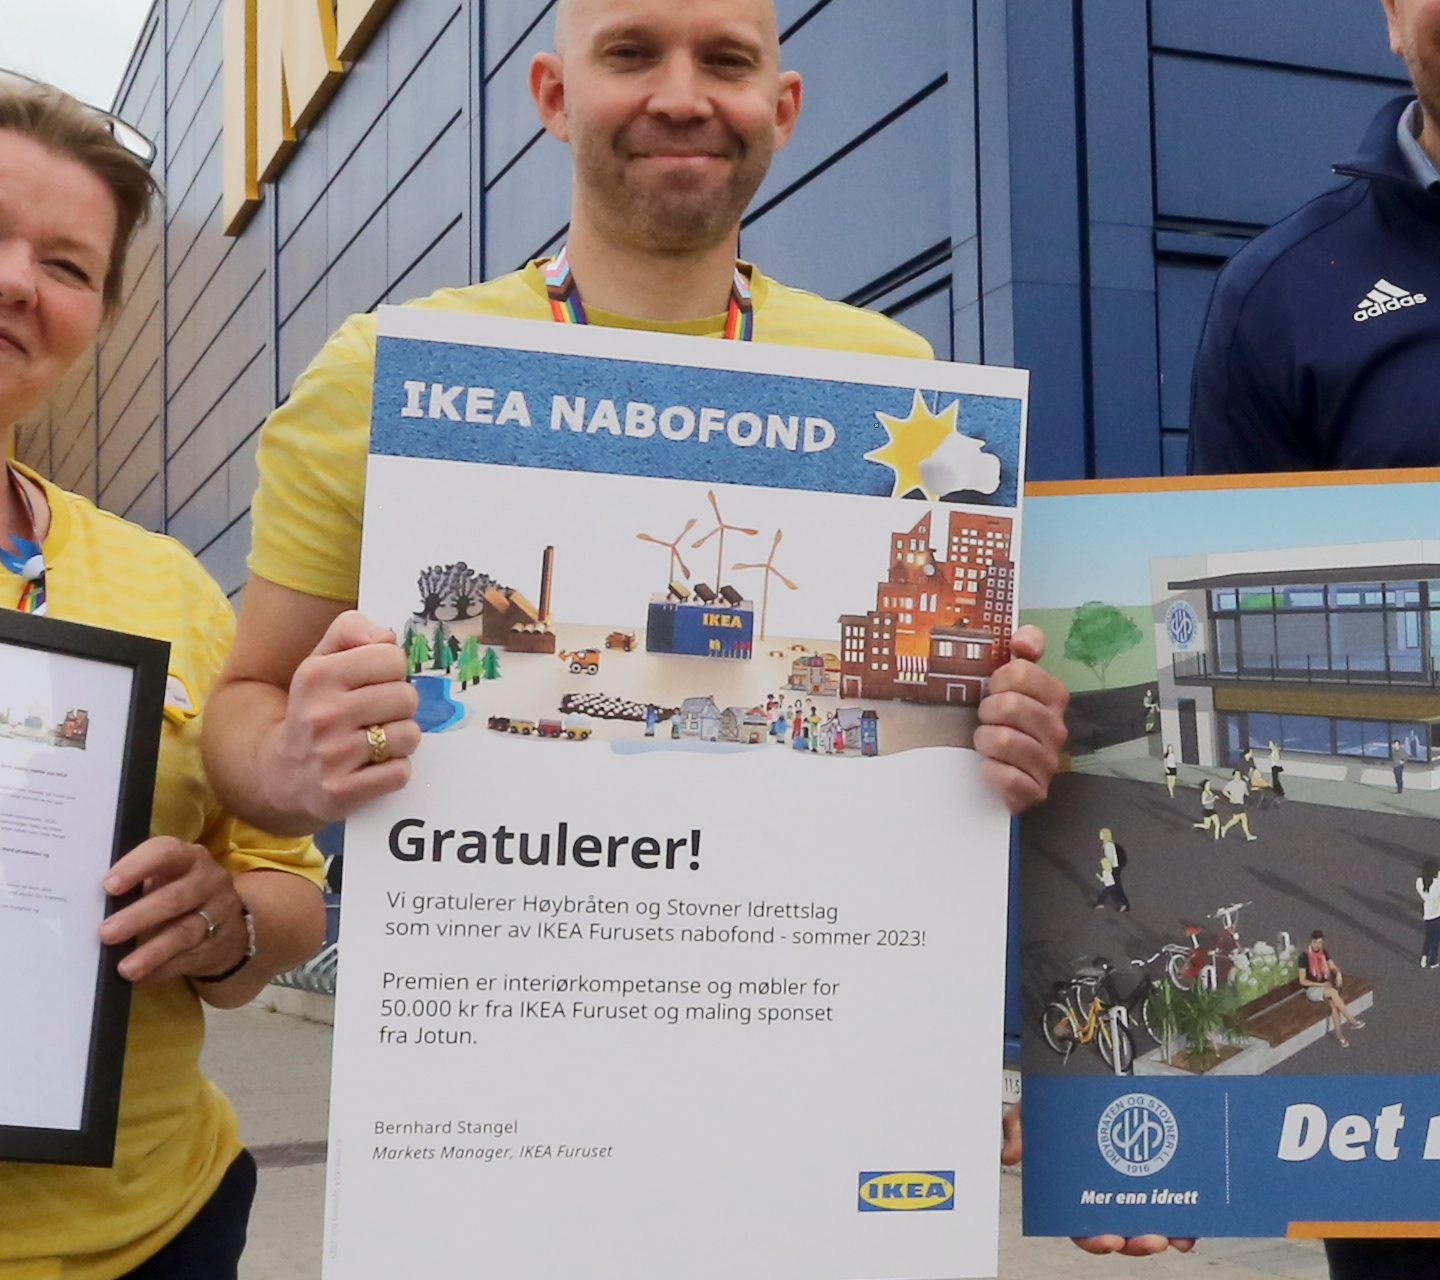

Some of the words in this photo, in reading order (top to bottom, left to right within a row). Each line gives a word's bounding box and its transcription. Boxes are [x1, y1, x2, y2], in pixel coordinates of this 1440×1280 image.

[1354, 288, 1426, 321] adidas
[401, 381, 531, 427] IKEA
[551, 395, 835, 452] NABOFOND
[703, 613, 742, 628] IKEA
[389, 819, 700, 870] Gratulerer!
[387, 892, 405, 908] Vi
[413, 893, 516, 914] gratulerer
[524, 895, 628, 917] Høybråten
[636, 902, 660, 920] og
[668, 899, 741, 916] Stovner
[749, 901, 837, 924] Idrettslag
[386, 922, 429, 935] som
[437, 920, 502, 937] vinner
[508, 925, 531, 938] av
[538, 923, 582, 939] IKEA
[590, 923, 674, 941] Furusets
[682, 925, 774, 943] nabofond
[793, 932, 871, 945] sommer
[877, 930, 925, 946] 2023!
[383, 972, 468, 990] Premien
[477, 978, 497, 990] er
[504, 974, 700, 997] interiørkompetanse
[708, 981, 731, 999] og
[739, 978, 807, 995] møbler
[813, 978, 840, 995] for
[381, 999, 451, 1017] 50.000
[459, 1000, 478, 1016] kr
[486, 1000, 512, 1017] fra
[521, 1001, 565, 1018] IKEA
[573, 1002, 647, 1019] Furuset
[654, 1007, 678, 1024] og
[686, 1003, 751, 1025] maling
[758, 1007, 832, 1025] sponset
[380, 1026, 407, 1043] fra
[415, 1027, 476, 1044] Jotun.
[375, 1121, 451, 1134] Bernhard
[458, 1120, 517, 1137] Stangel
[1148, 1100, 1176, 1149] STOVNER
[1278, 1103, 1405, 1160] Det
[373, 1146, 435, 1159] Markets
[441, 1146, 512, 1162] Manager,
[520, 1145, 551, 1158] IKEA
[557, 1145, 613, 1158] Furuset
[1127, 1164, 1150, 1172] 1916
[869, 1183, 946, 1199] IKEA
[1081, 1191, 1112, 1204] Mer
[1116, 1193, 1147, 1204] enn
[1151, 1189, 1198, 1204] idrett
